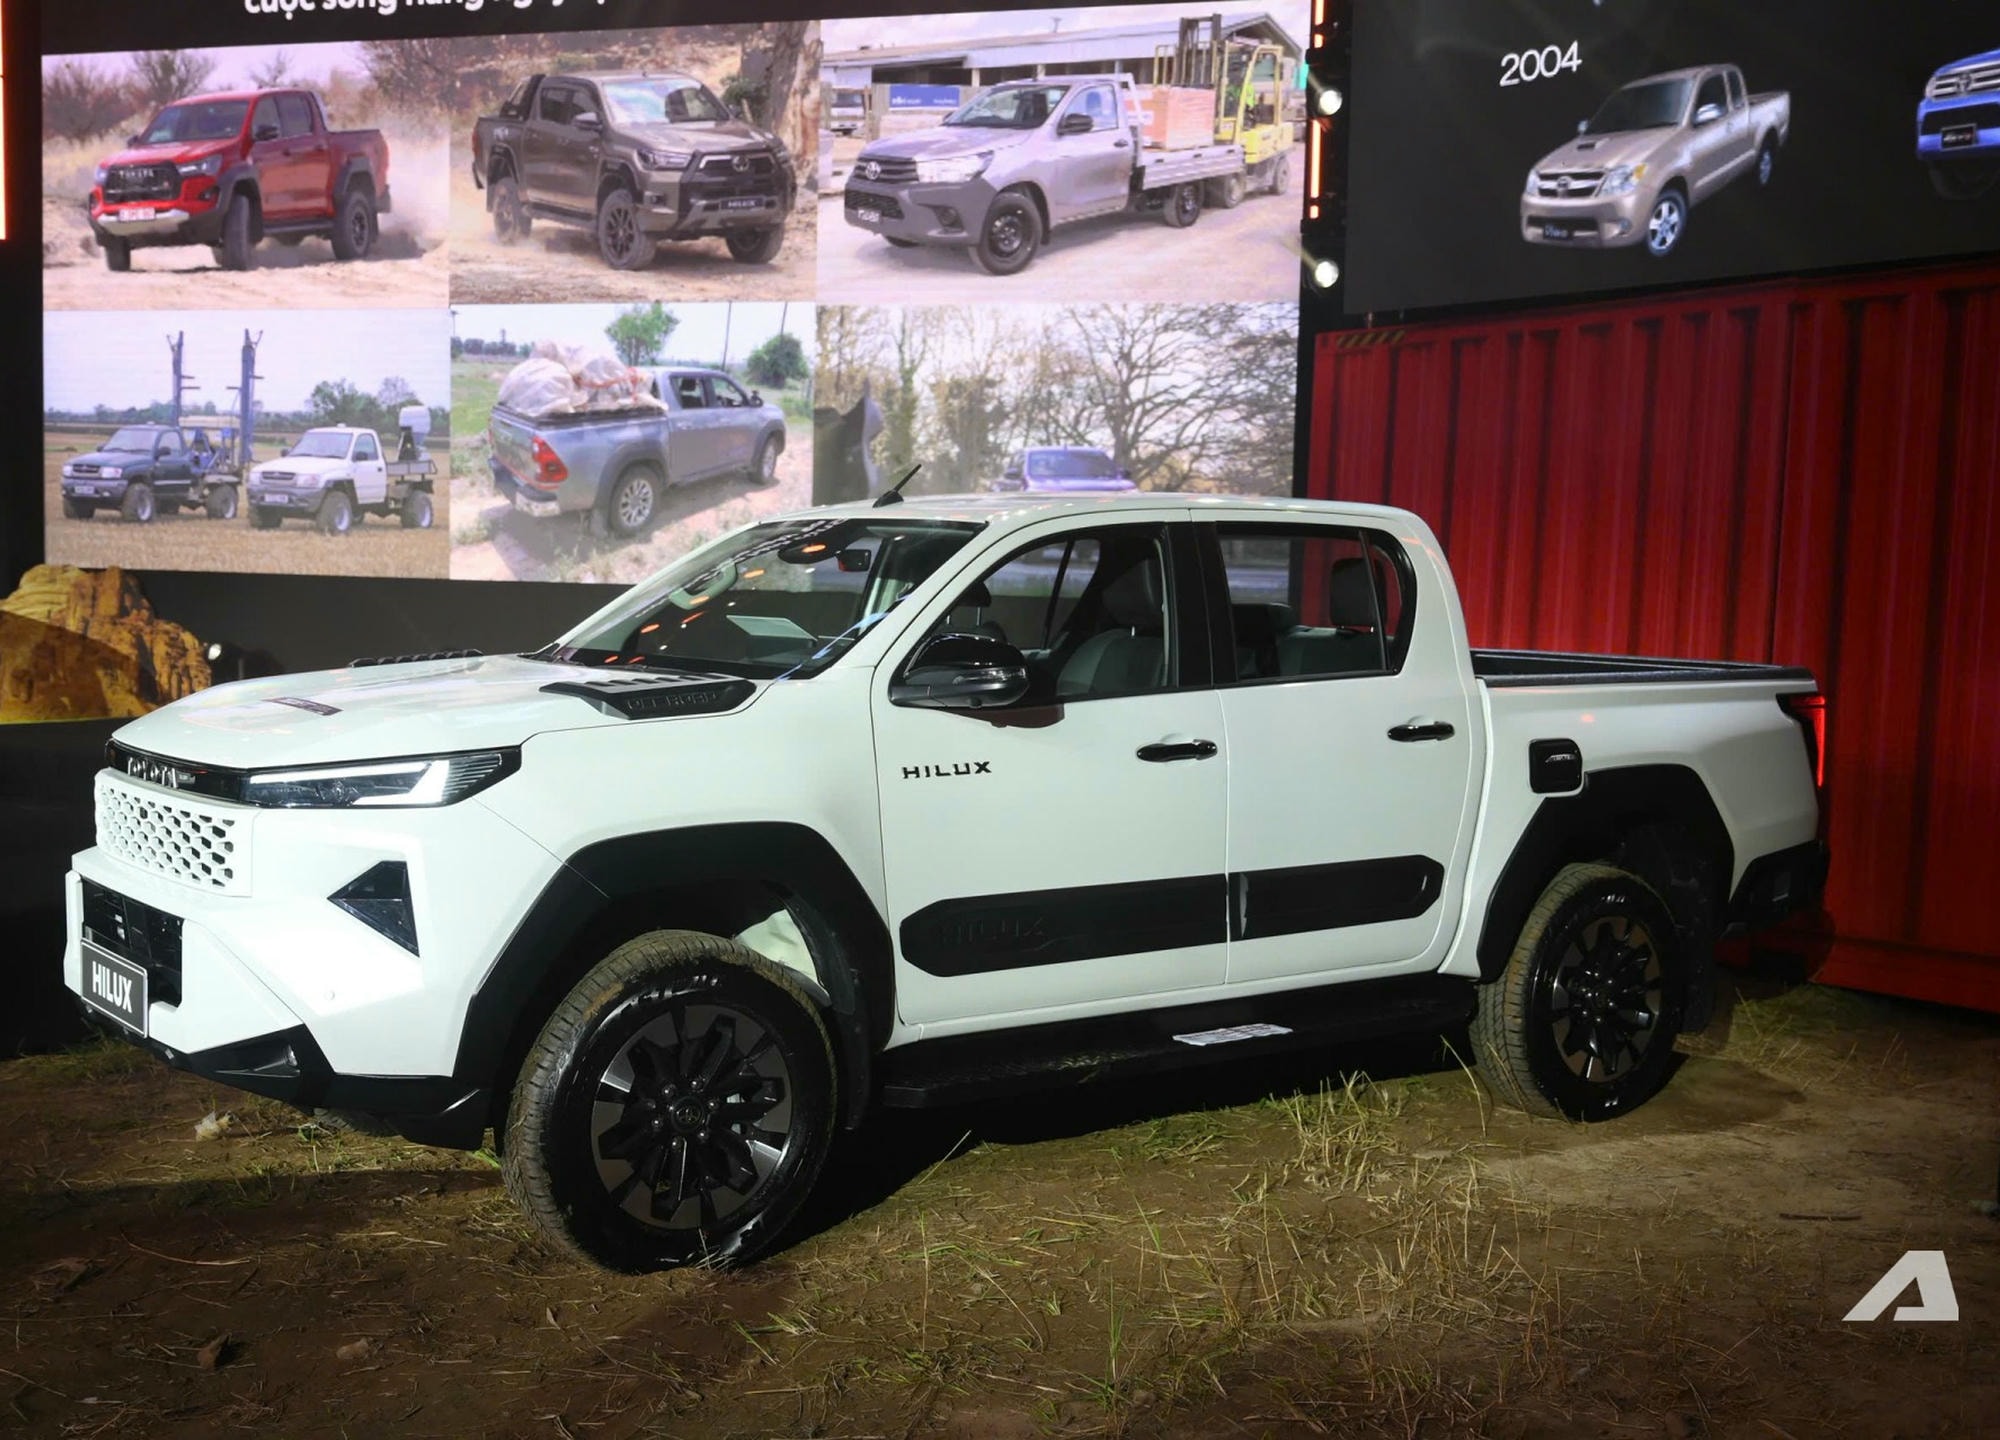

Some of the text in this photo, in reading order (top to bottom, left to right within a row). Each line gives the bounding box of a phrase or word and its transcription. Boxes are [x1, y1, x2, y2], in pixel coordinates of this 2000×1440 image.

[1499, 40, 1583, 87] 2004
[902, 761, 992, 779] HILUX
[92, 961, 133, 1013] HILUX
